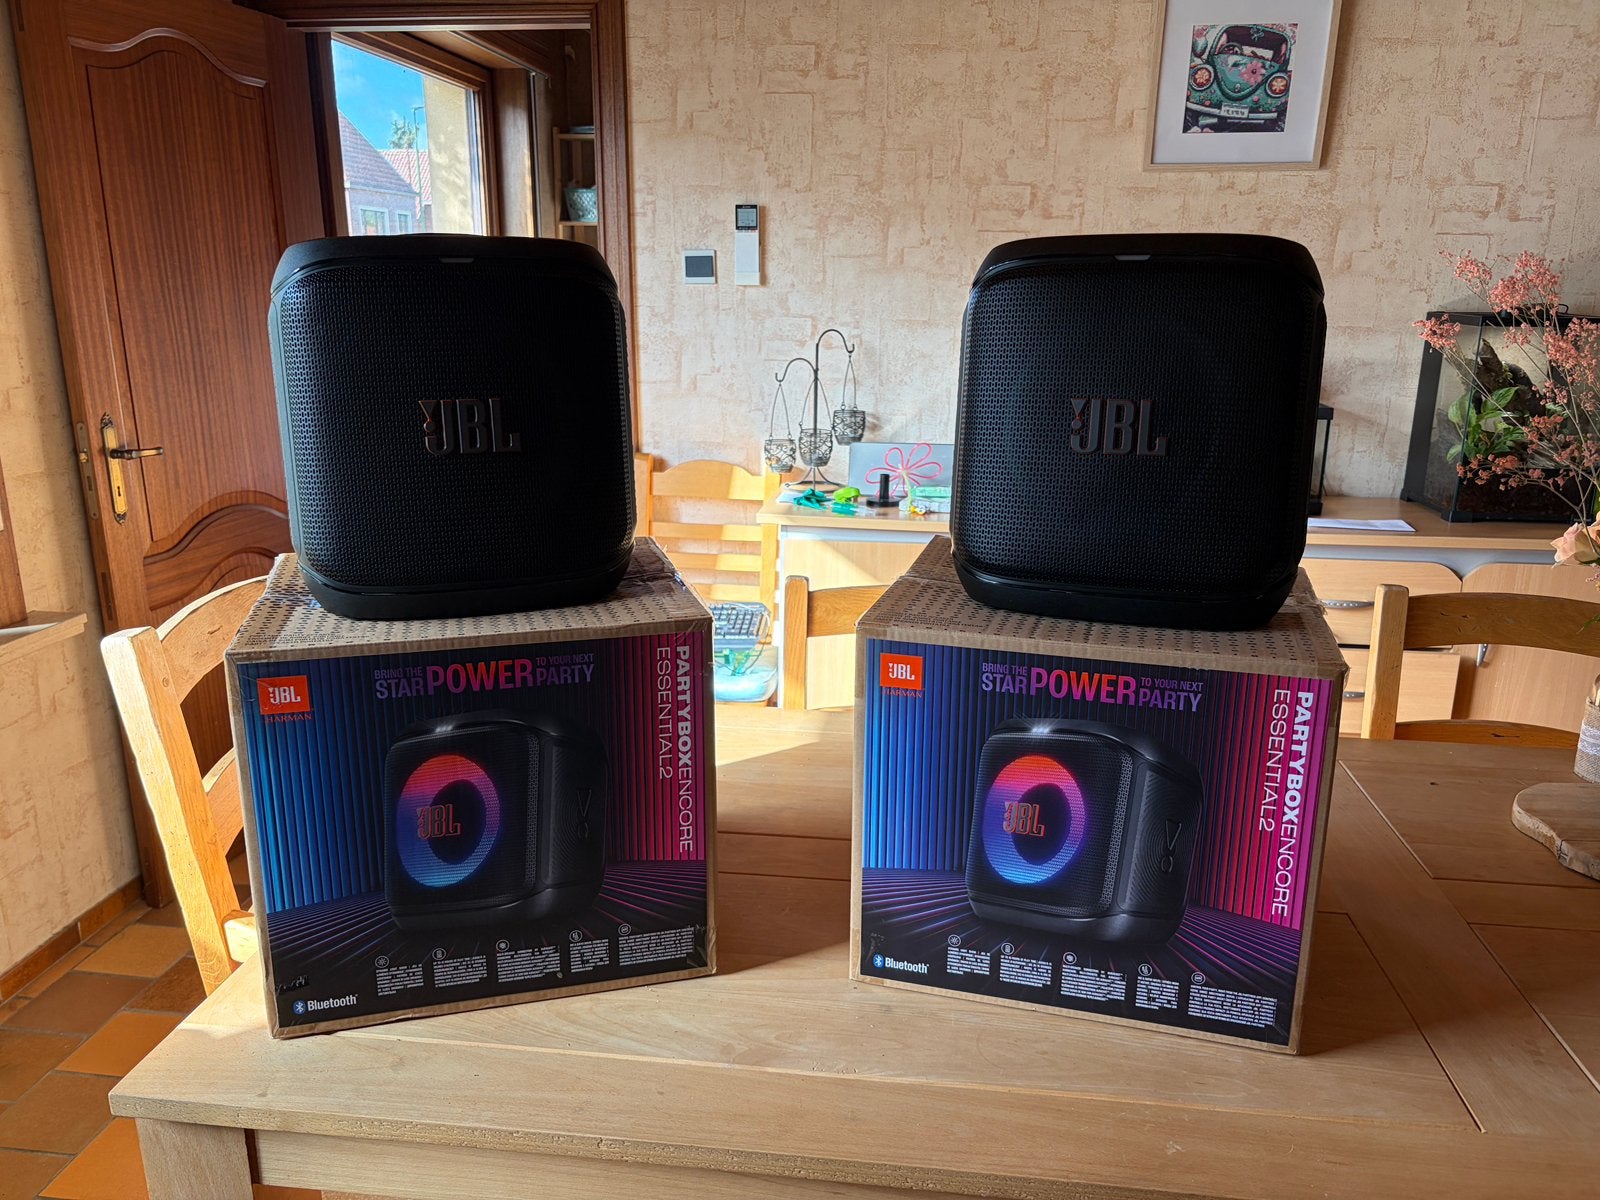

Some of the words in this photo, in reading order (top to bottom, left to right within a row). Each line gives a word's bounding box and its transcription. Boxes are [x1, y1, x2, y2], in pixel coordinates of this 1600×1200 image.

[419, 398, 521, 455] JBL
[1070, 397, 1168, 456] JBL
[536, 656, 546, 666] TO
[549, 654, 571, 665] YOUR
[573, 653, 595, 664] NEXT
[374, 668, 403, 680] BRING
[405, 666, 423, 677] THE
[888, 662, 915, 680] JBL
[982, 662, 1010, 674] BRING
[1011, 665, 1028, 676] THE
[375, 677, 425, 699] STAR
[426, 658, 534, 695] POWER
[536, 664, 595, 687] PARTY
[1140, 677, 1152, 687] TO
[1153, 678, 1178, 689] YOUR
[1179, 680, 1204, 692] NEXT
[267, 685, 301, 705] JBL
[881, 689, 923, 698] HARMAN
[981, 672, 1027, 695] STAR
[1029, 667, 1137, 706] POWER
[1138, 688, 1203, 712] PARTY
[266, 713, 313, 723] HARMAN
[416, 803, 462, 840] JBL
[1002, 800, 1046, 838] JBL
[885, 957, 928, 974] Bluetooth
[307, 995, 357, 1011] Bluetooth
